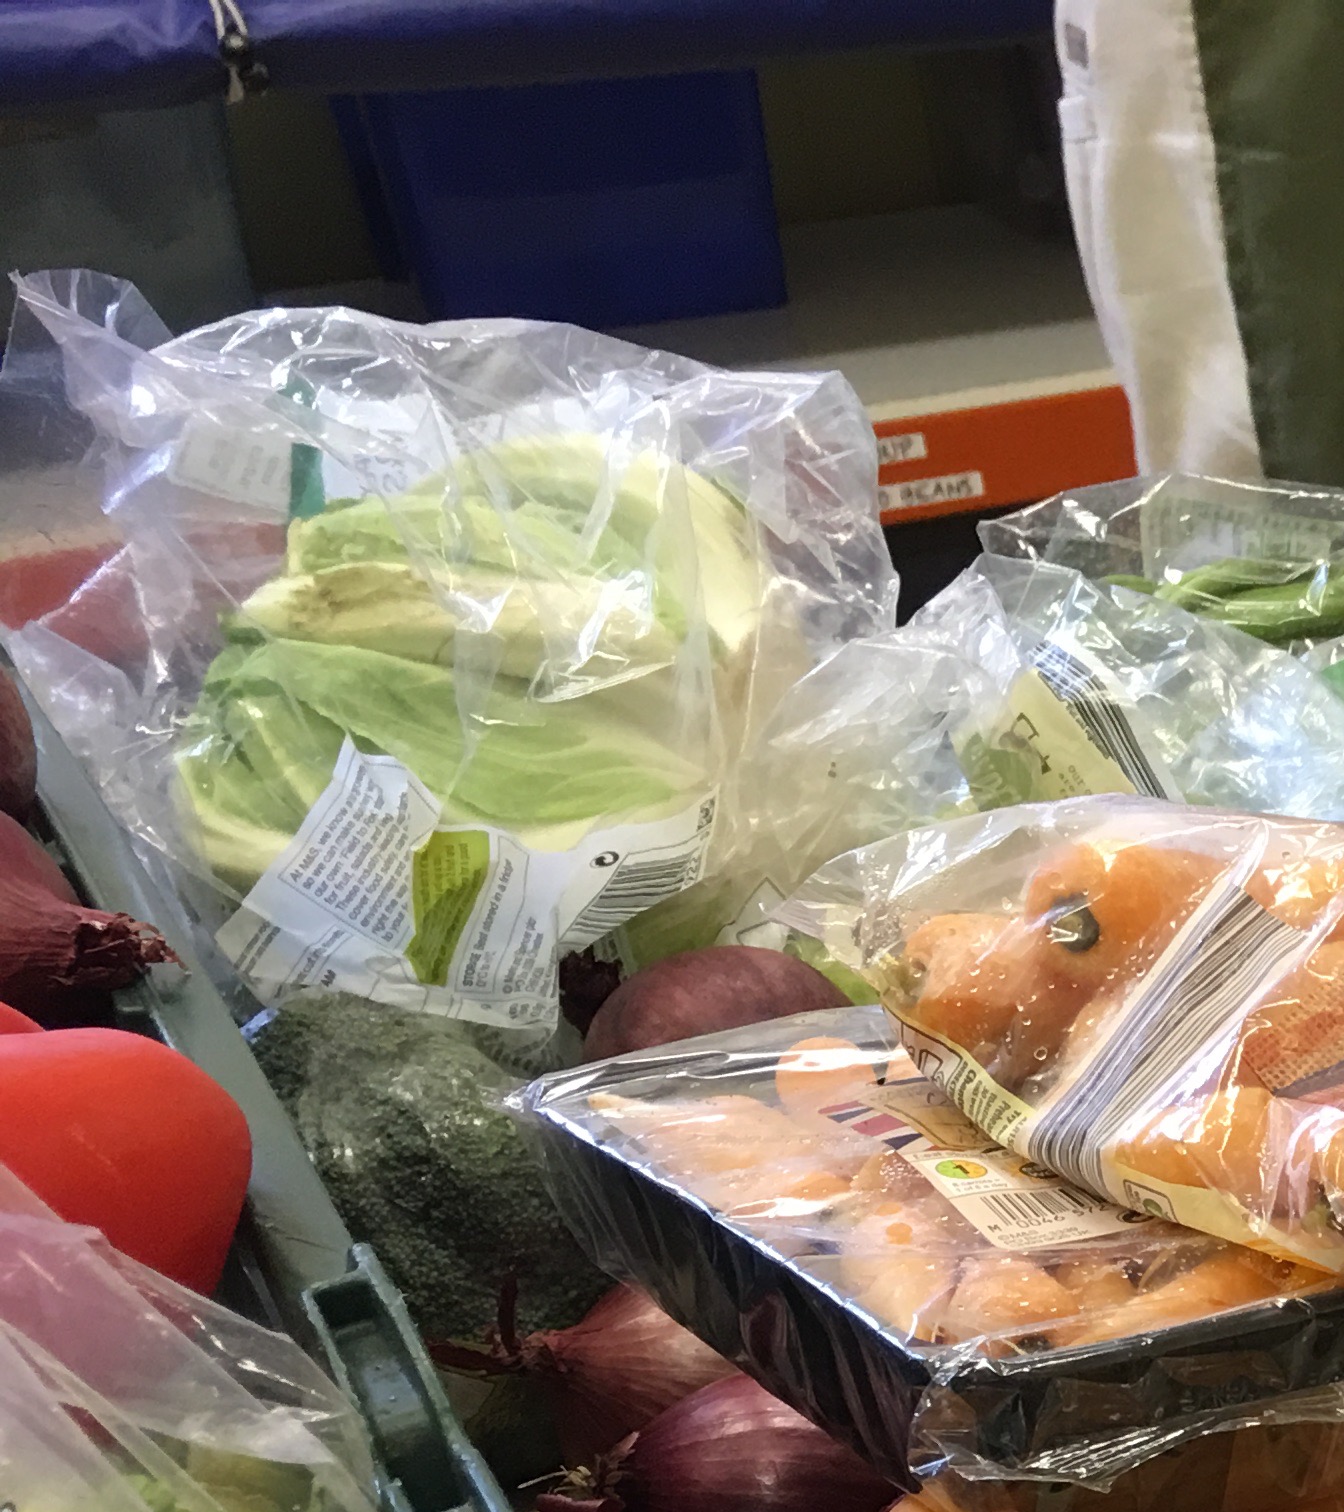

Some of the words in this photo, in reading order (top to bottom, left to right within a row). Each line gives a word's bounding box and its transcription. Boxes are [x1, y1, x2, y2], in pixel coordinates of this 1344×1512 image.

[325, 804, 348, 833] know
[321, 843, 339, 864] can
[333, 818, 355, 847] make
[313, 879, 329, 898] our
[324, 858, 344, 883] own
[365, 872, 383, 895] food
[334, 880, 360, 913] These
[358, 871, 399, 931] environment
[369, 913, 390, 937] right
[382, 896, 400, 915] the
[388, 909, 407, 932] your
[480, 901, 500, 932] stored
[472, 930, 489, 952] Best
[1016, 1213, 1066, 1230] 0046
